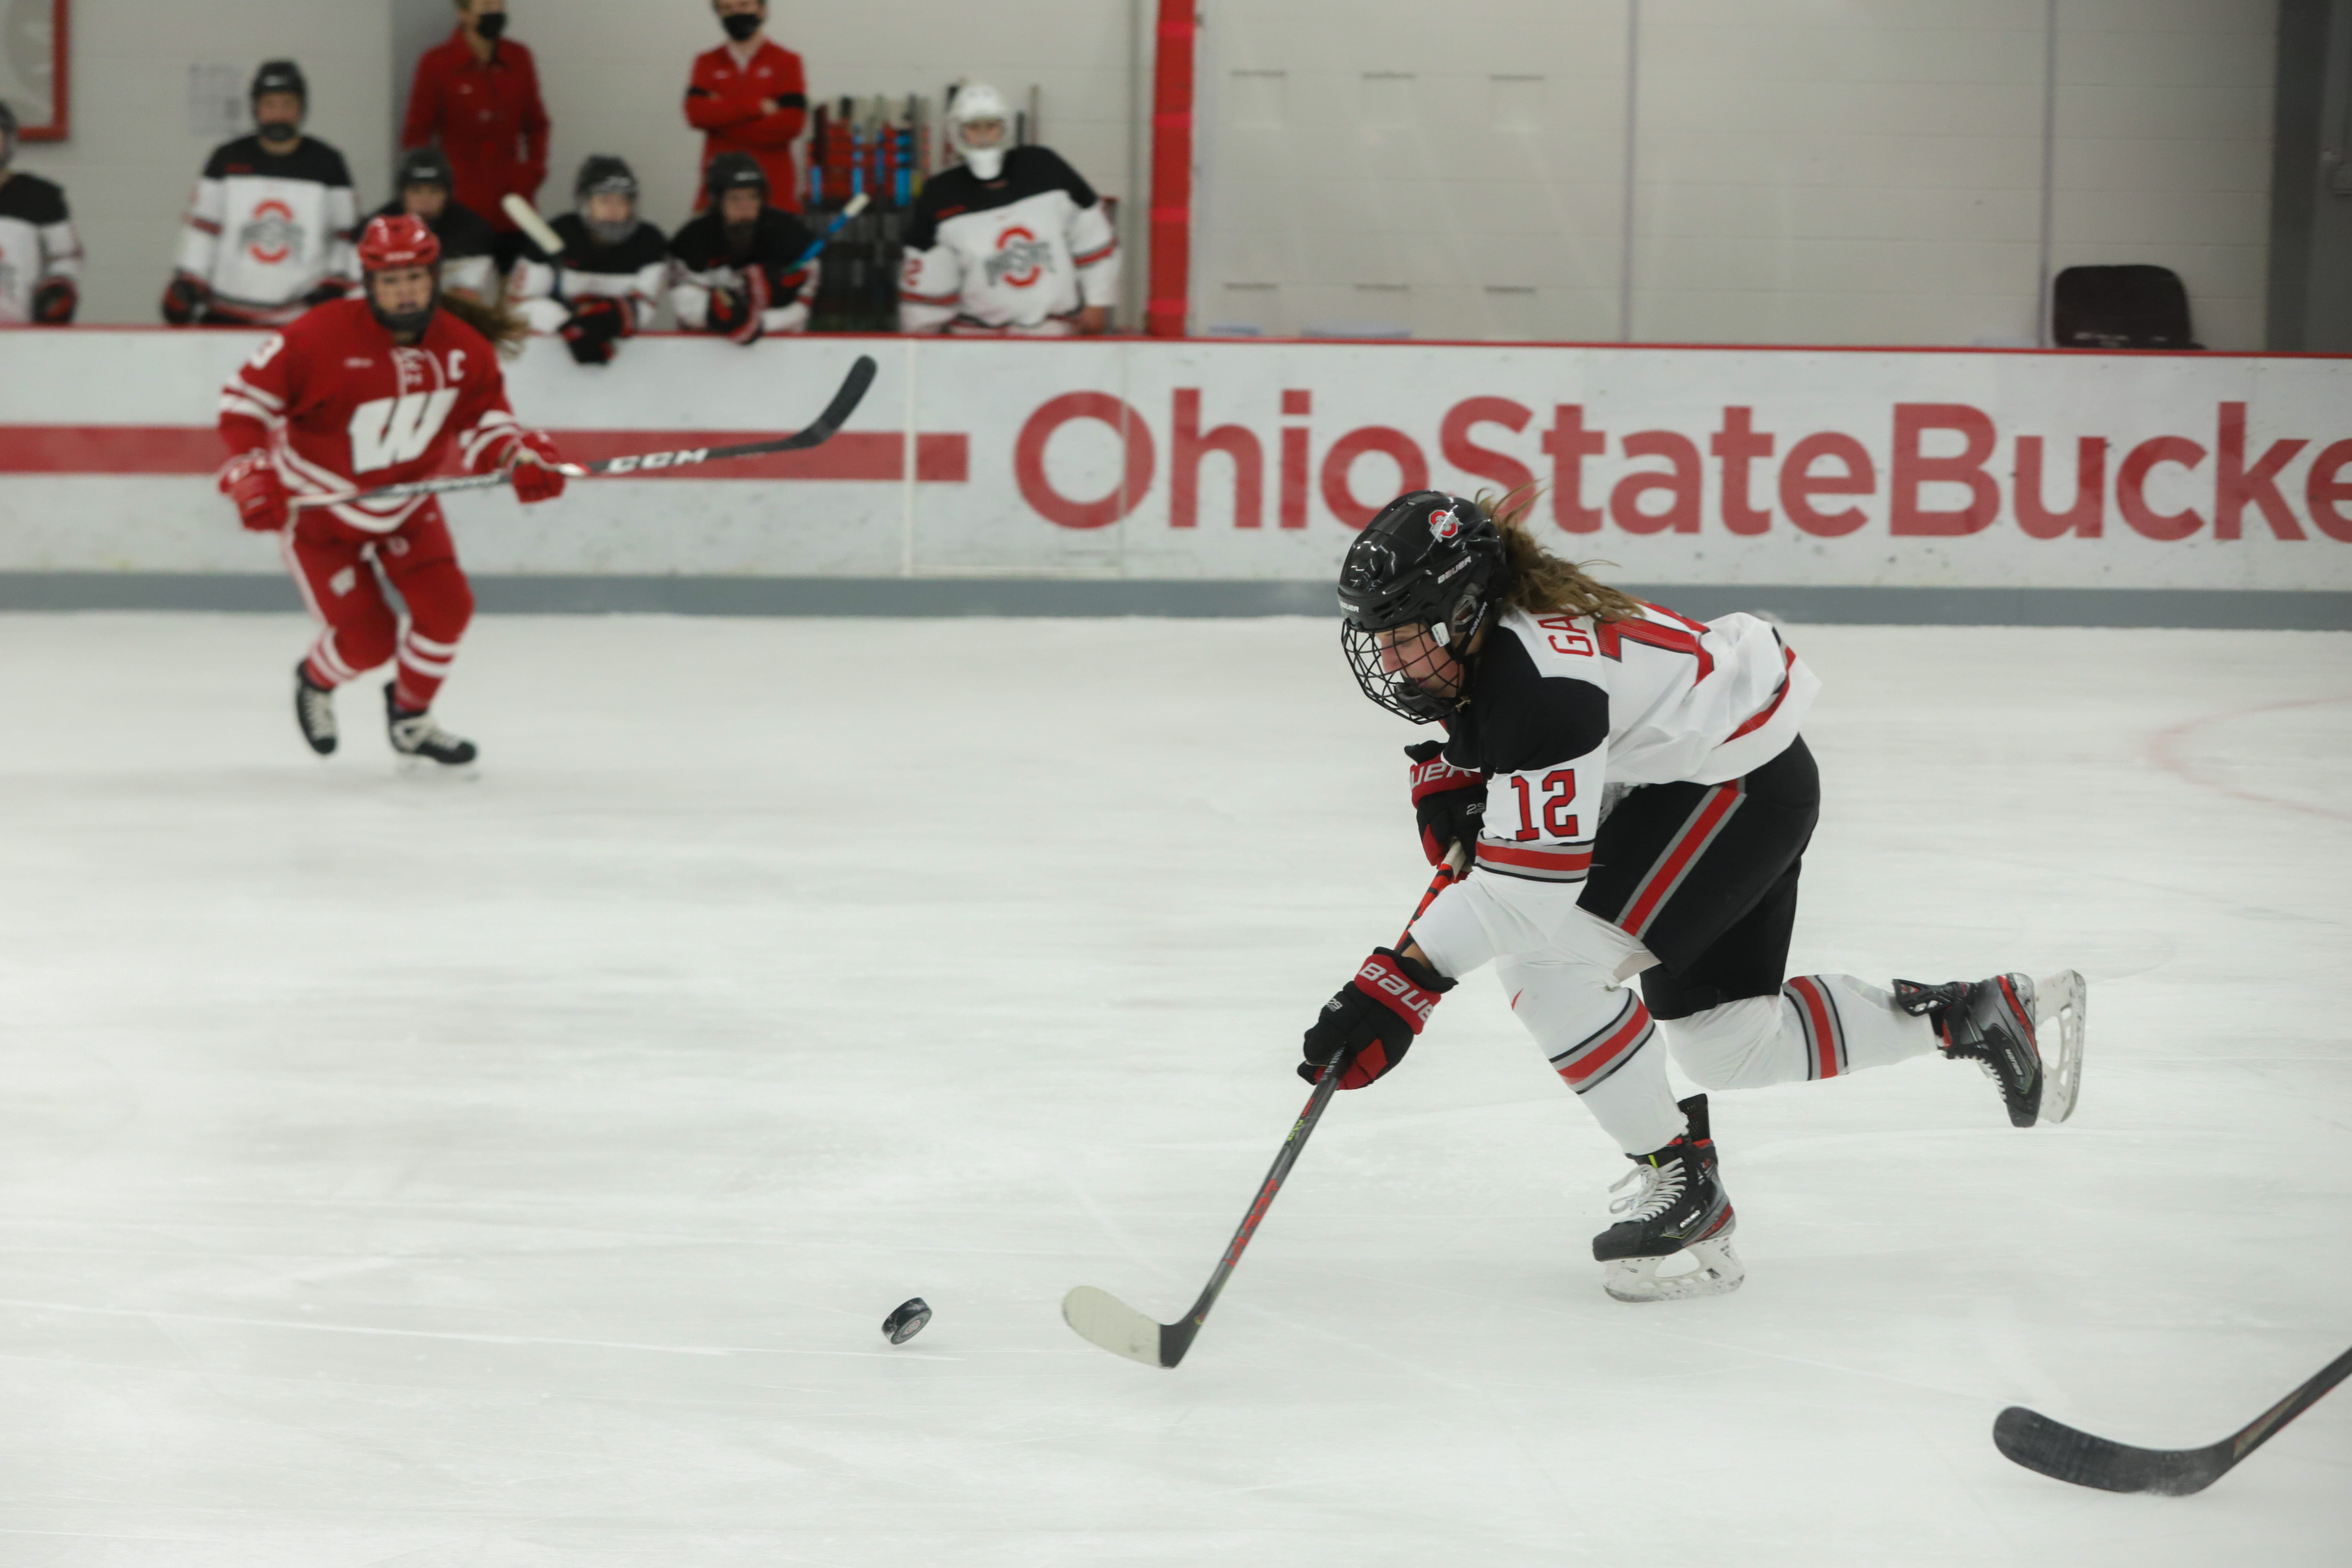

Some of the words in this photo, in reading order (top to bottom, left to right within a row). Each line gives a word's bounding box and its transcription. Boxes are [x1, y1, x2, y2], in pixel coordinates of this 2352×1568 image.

[448, 349, 467, 381] C
[347, 387, 460, 476] W
[606, 447, 709, 474] CCM
[1531, 610, 1594, 657] GA
[1511, 769, 1579, 841] 12
